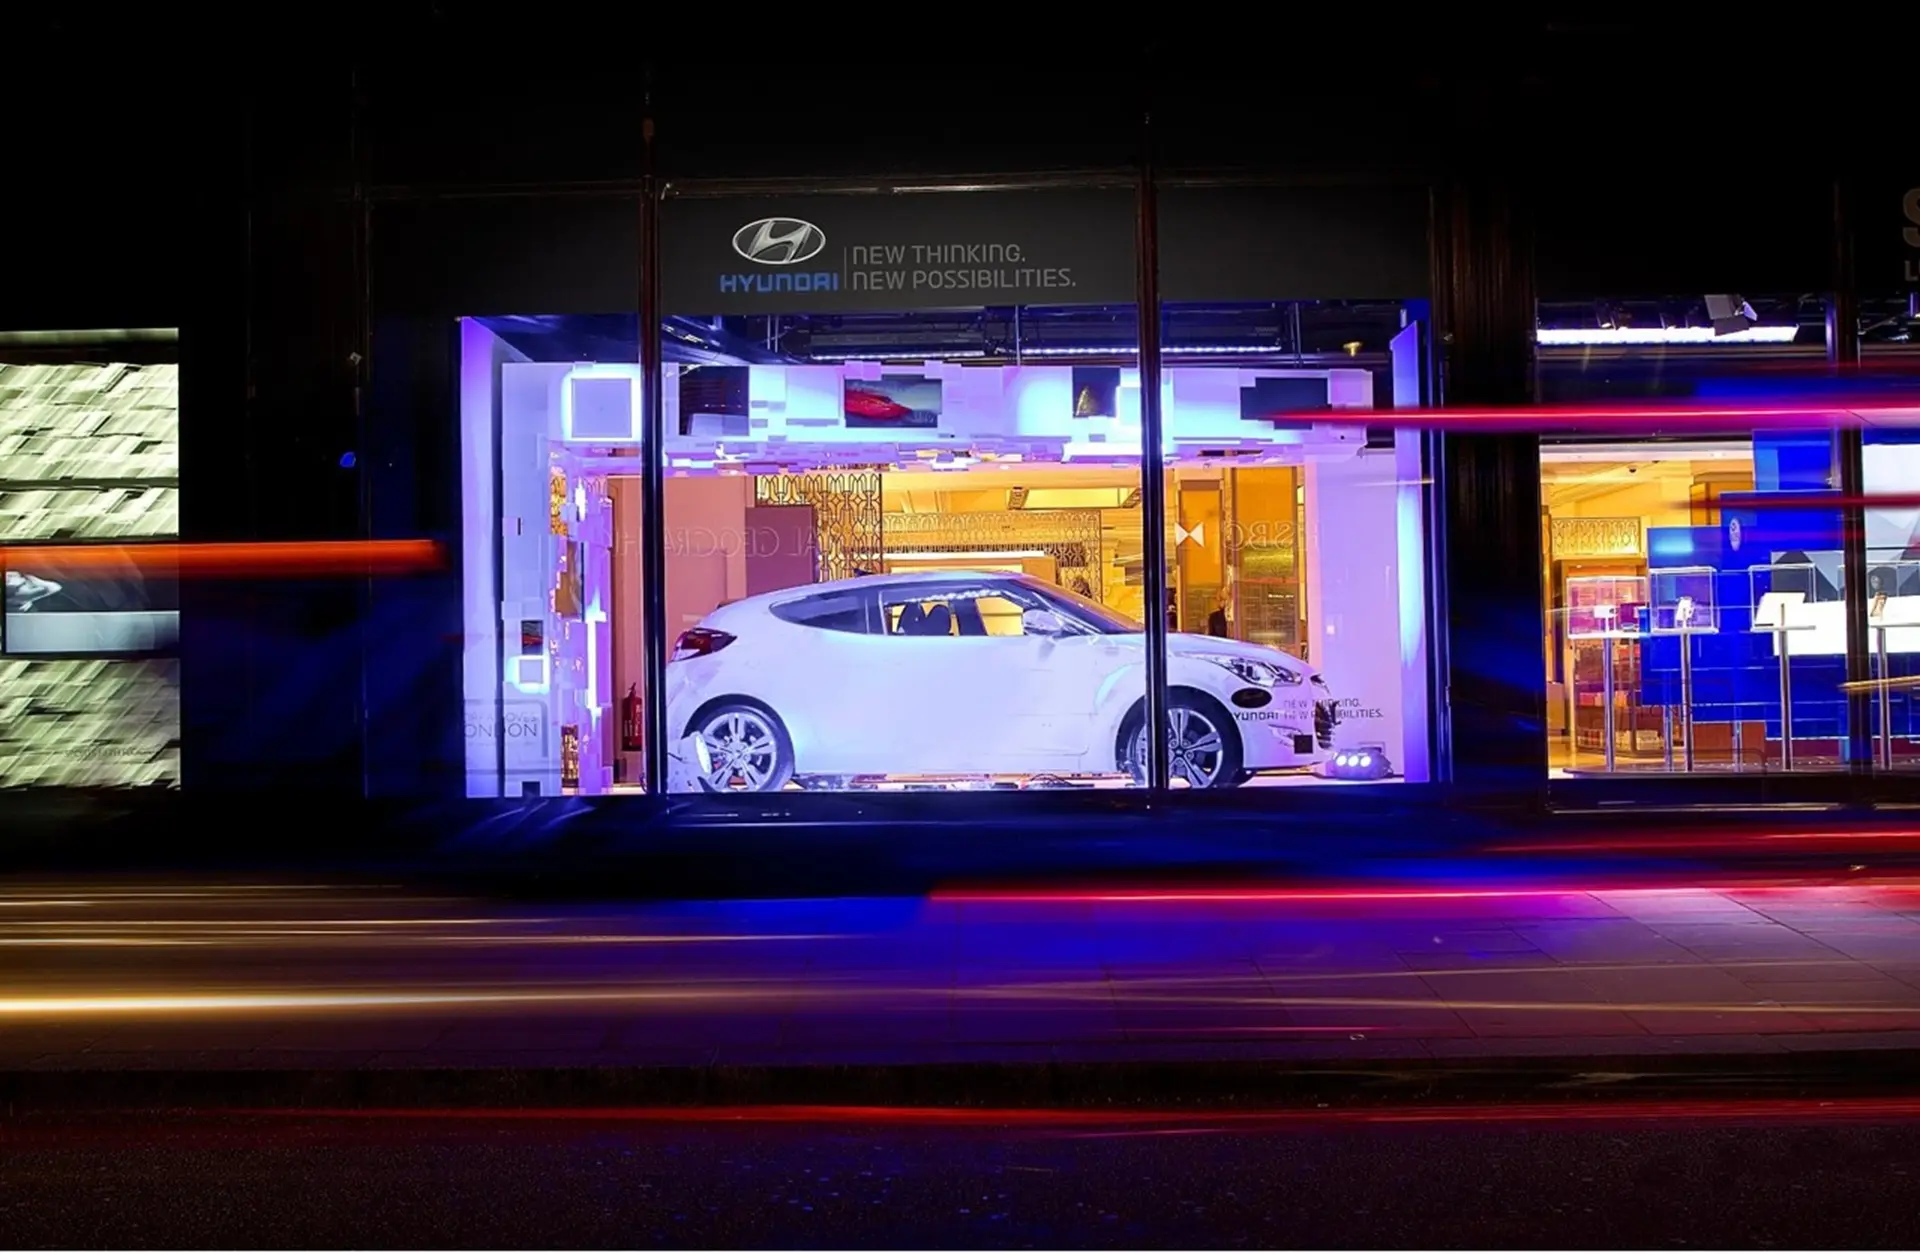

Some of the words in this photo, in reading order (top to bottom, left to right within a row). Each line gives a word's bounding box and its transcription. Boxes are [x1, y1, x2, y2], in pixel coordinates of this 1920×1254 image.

[852, 245, 905, 266] NEW
[912, 243, 1026, 265] THINKING.
[719, 273, 839, 293] HYUNDAI
[852, 270, 905, 291] NEW
[911, 267, 1077, 289] POSSIBILITIES.
[1232, 711, 1279, 721] YUNDAI
